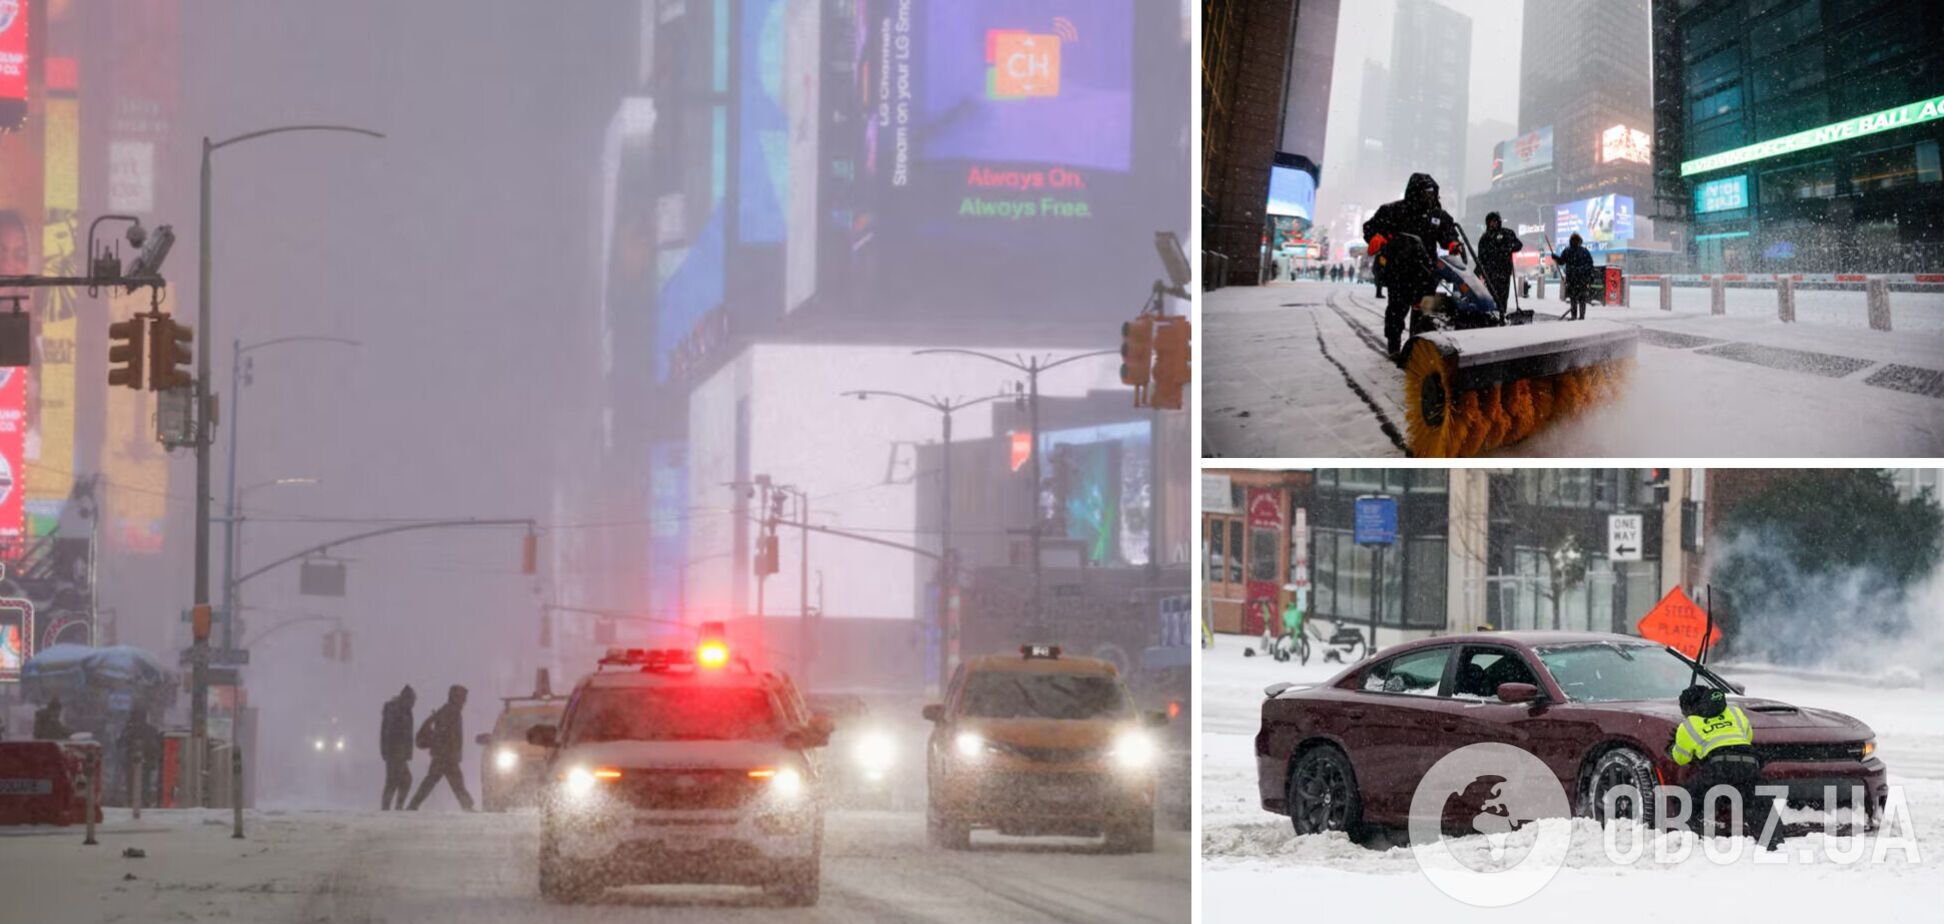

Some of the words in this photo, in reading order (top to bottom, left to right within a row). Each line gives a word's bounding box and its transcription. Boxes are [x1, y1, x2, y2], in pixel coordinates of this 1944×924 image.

[880, 17, 891, 100] Channels
[896, 35, 910, 60] LG
[1007, 52, 1049, 79] CH
[898, 64, 912, 100] your
[880, 103, 890, 126] LG
[897, 102, 908, 125] on
[1757, 138, 1798, 158] DECK
[1814, 126, 1853, 143] NYE
[1858, 108, 1913, 132] BALL
[894, 127, 908, 187] Stream
[968, 166, 1043, 191] Always
[1049, 166, 1085, 189] On.
[959, 197, 1036, 220] Always
[1040, 198, 1092, 217] Free.
[1614, 518, 1636, 529] ONE
[1614, 531, 1636, 542] WAY
[1664, 605, 1697, 619] STEEL
[1658, 623, 1699, 638] PLATES
